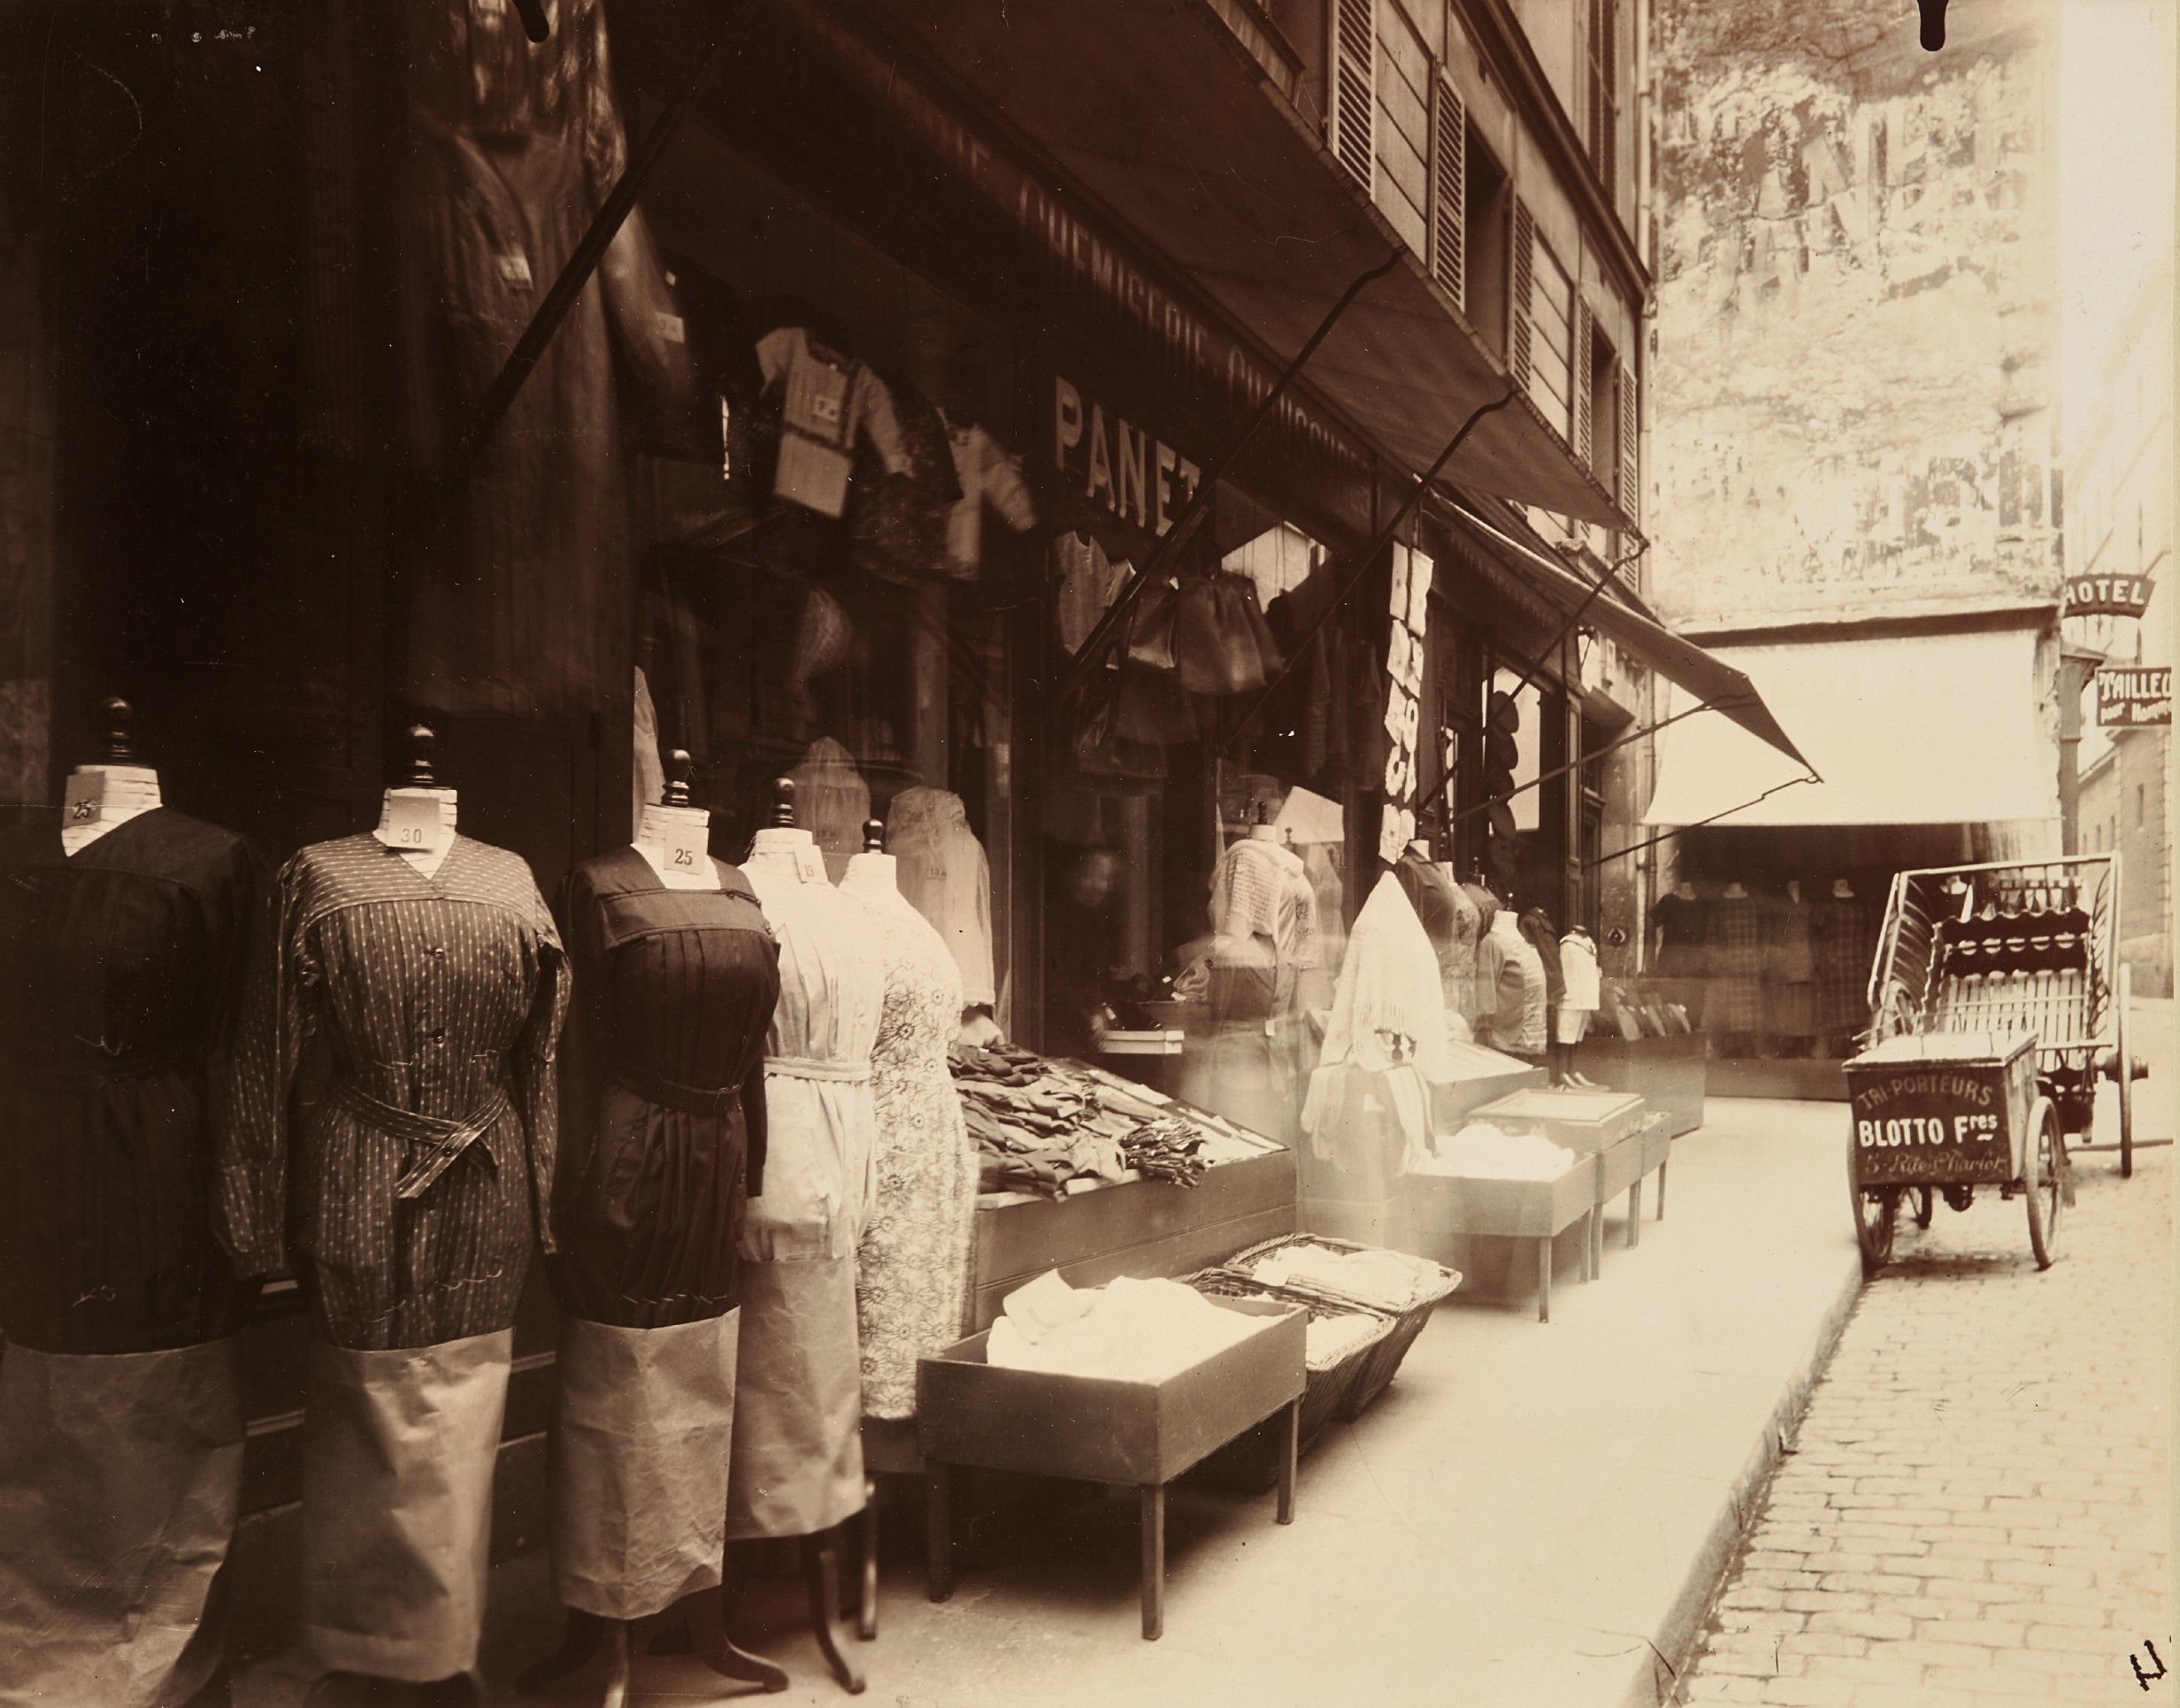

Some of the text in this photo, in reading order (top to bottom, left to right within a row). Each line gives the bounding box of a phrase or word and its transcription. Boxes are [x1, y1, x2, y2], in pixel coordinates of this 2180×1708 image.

[401, 828, 422, 843] 30
[674, 848, 693, 866] 25
[1859, 1114, 1998, 1147] BLOTTO Fres
